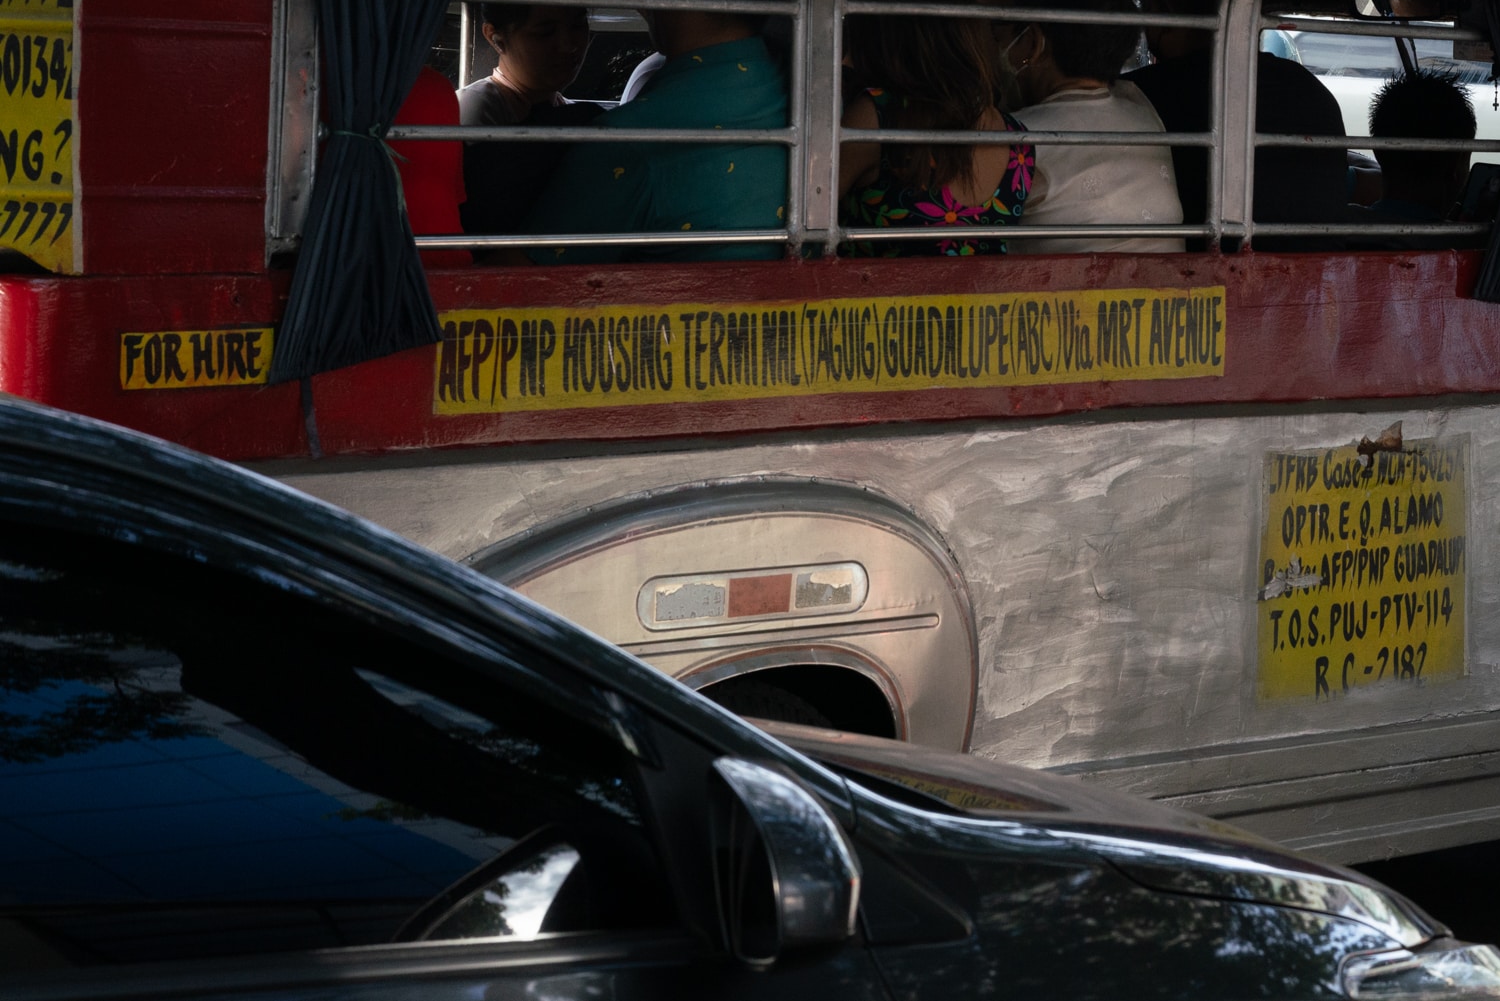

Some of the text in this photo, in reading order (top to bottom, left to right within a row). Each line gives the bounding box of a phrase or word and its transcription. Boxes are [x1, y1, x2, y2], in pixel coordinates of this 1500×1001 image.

[0, 200, 73, 246] 7777
[123, 330, 262, 386] FOR HIRE
[437, 315, 556, 407] AFP/PNP
[562, 312, 673, 394] HOUSING
[1097, 298, 1146, 369] MRT
[1148, 296, 1222, 368] AVENUE
[1281, 503, 1334, 548] OPTR.
[1379, 491, 1444, 537] ALAMO
[1319, 544, 1390, 595] AFP/PNP
